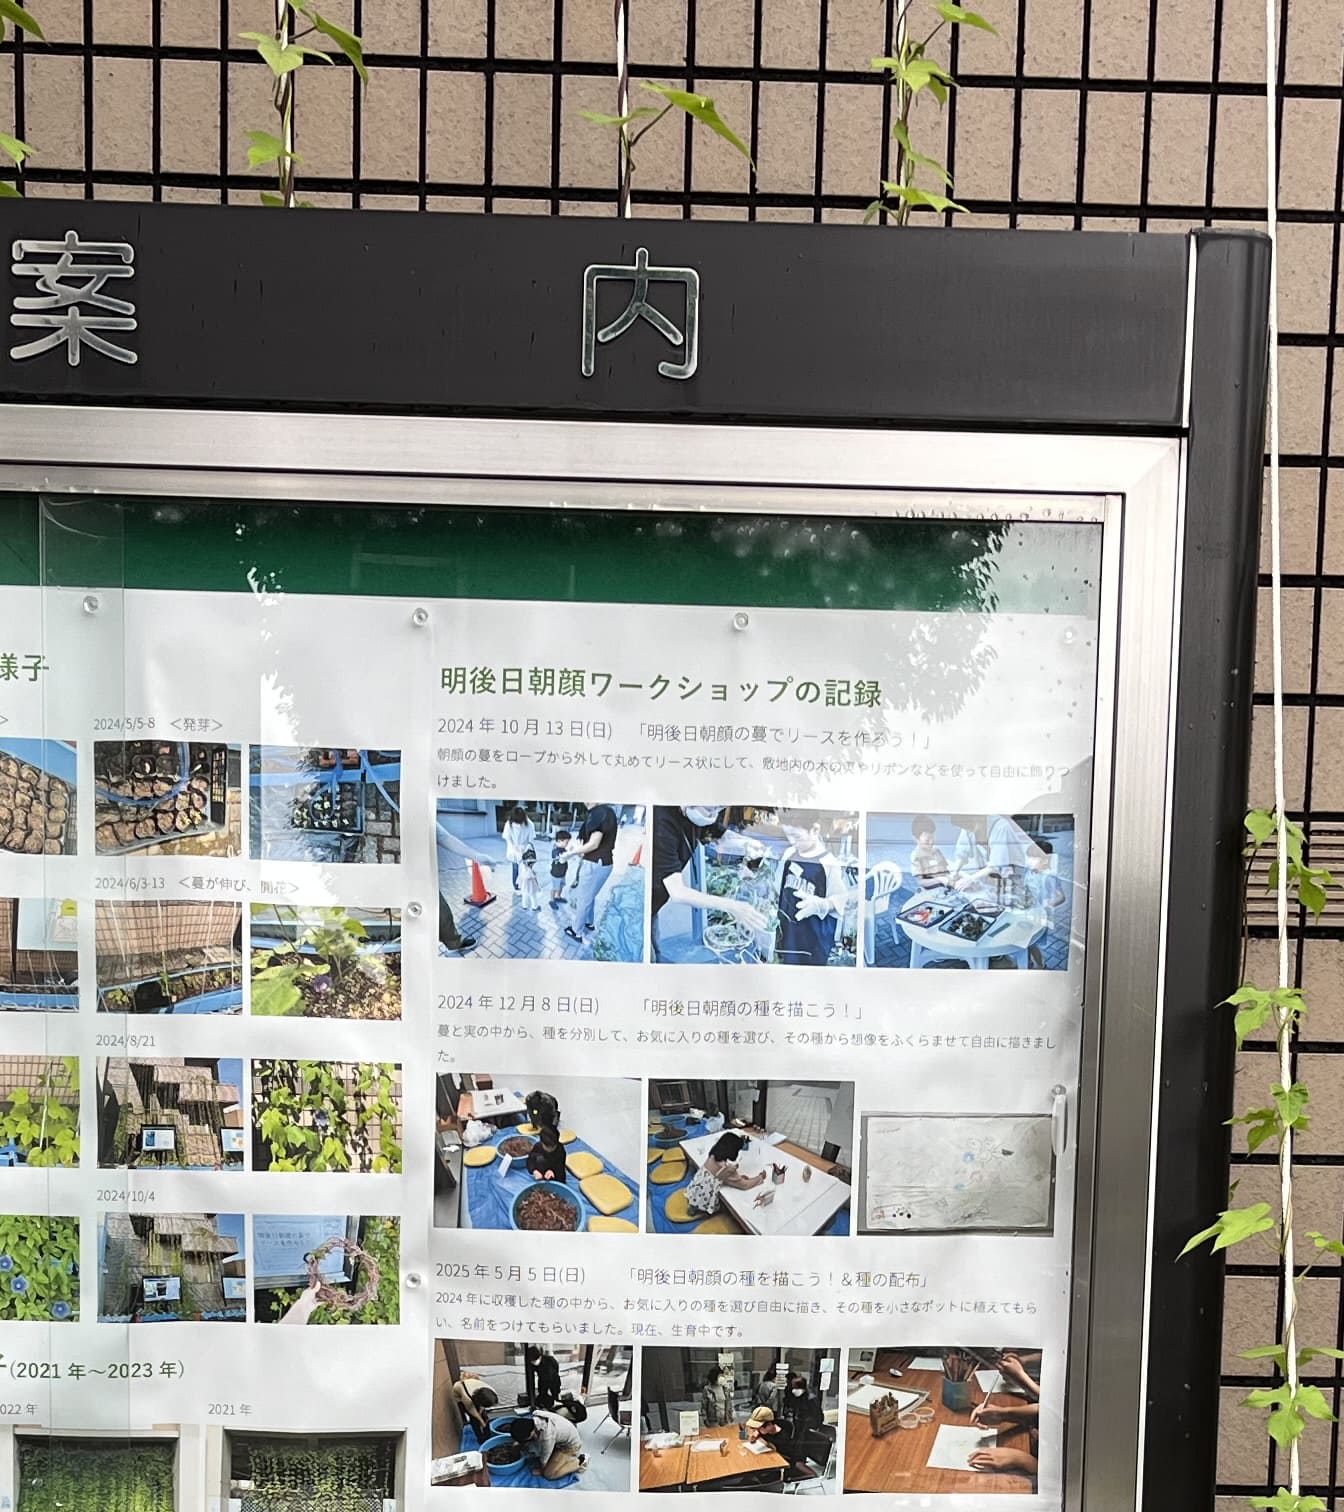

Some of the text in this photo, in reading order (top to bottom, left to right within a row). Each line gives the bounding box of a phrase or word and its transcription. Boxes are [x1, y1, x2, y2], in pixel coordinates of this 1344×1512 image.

[440, 666, 882, 708] 明後日朝顔ワークショップの記録
[93, 717, 156, 731] 2024/5/5-8
[437, 774, 497, 789] けました。
[95, 876, 165, 890] 2024/6/3-13
[96, 1034, 156, 1048] 2024/8/21
[437, 1050, 456, 1063] た。
[96, 1189, 156, 1204] 2024/10/4
